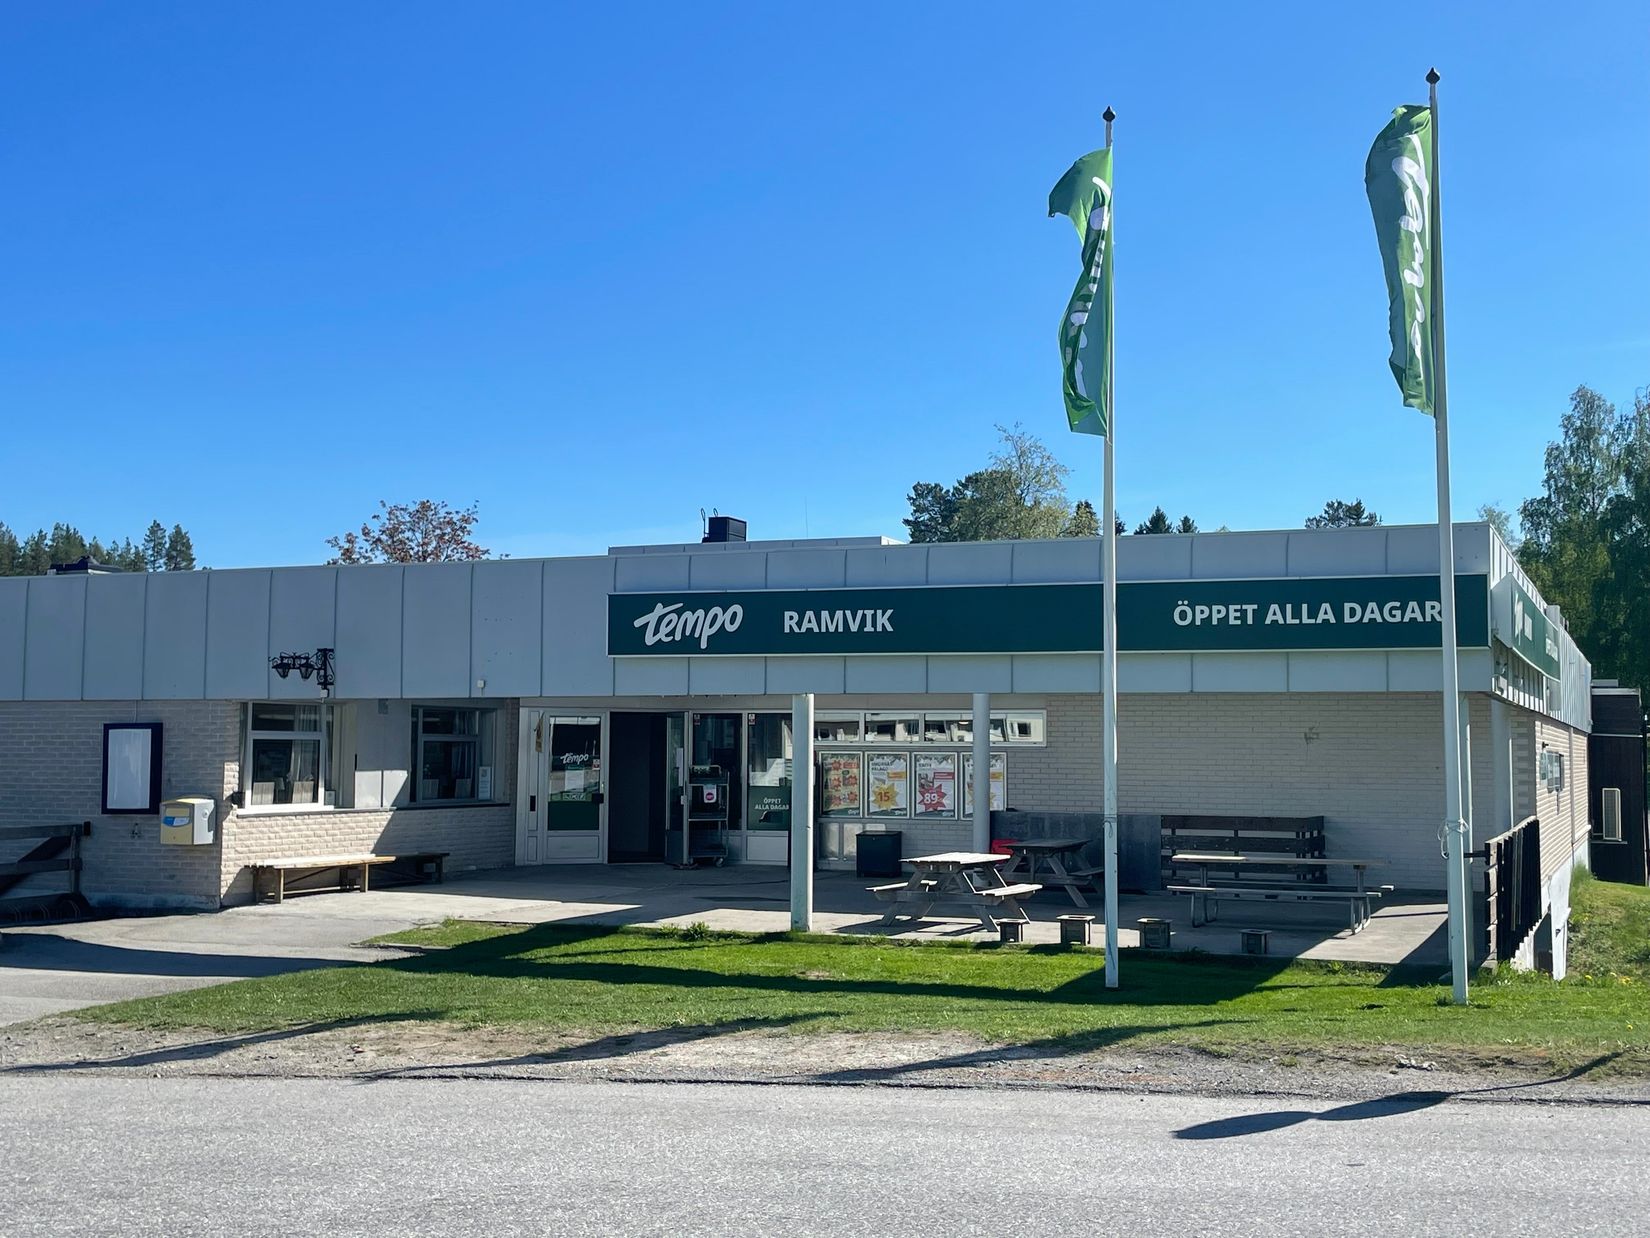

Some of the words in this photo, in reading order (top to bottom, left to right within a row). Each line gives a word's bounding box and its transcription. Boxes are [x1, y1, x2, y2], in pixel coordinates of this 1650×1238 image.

[633, 602, 744, 649] tempo
[783, 609, 894, 633] RAMVIK
[1173, 600, 1258, 626] ÖPPET
[1264, 602, 1336, 625] ALLA
[1343, 600, 1442, 624] DAGAR
